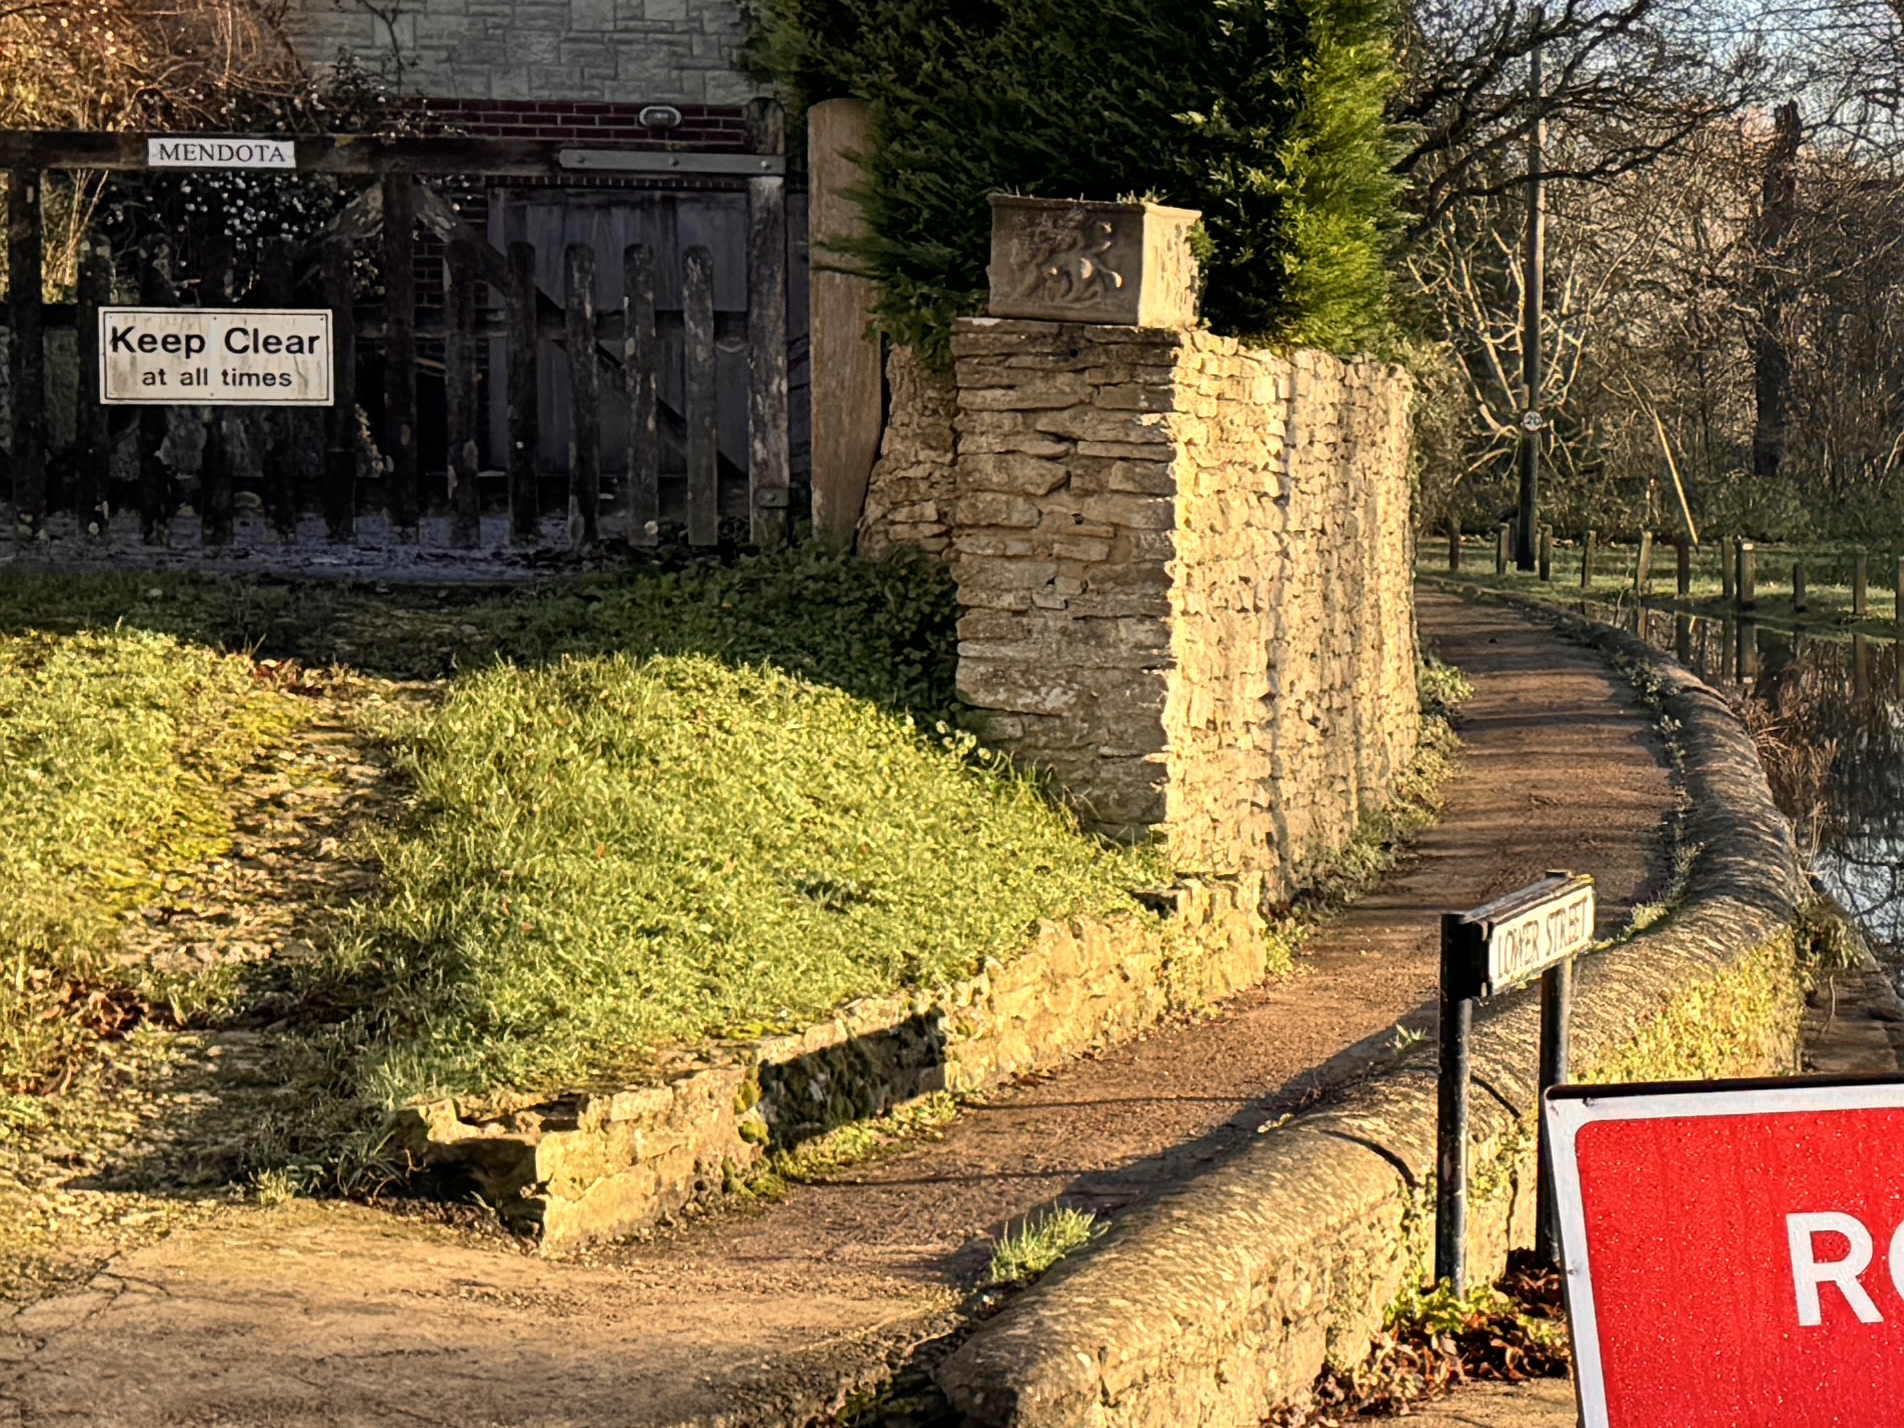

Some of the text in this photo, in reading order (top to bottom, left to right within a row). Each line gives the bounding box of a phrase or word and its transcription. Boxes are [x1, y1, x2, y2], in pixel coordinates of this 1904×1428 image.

[159, 143, 286, 163] MENDOTA
[111, 325, 320, 359] Keep Clear
[142, 367, 293, 387] at all times
[1497, 895, 1589, 980] LOWER STREET
